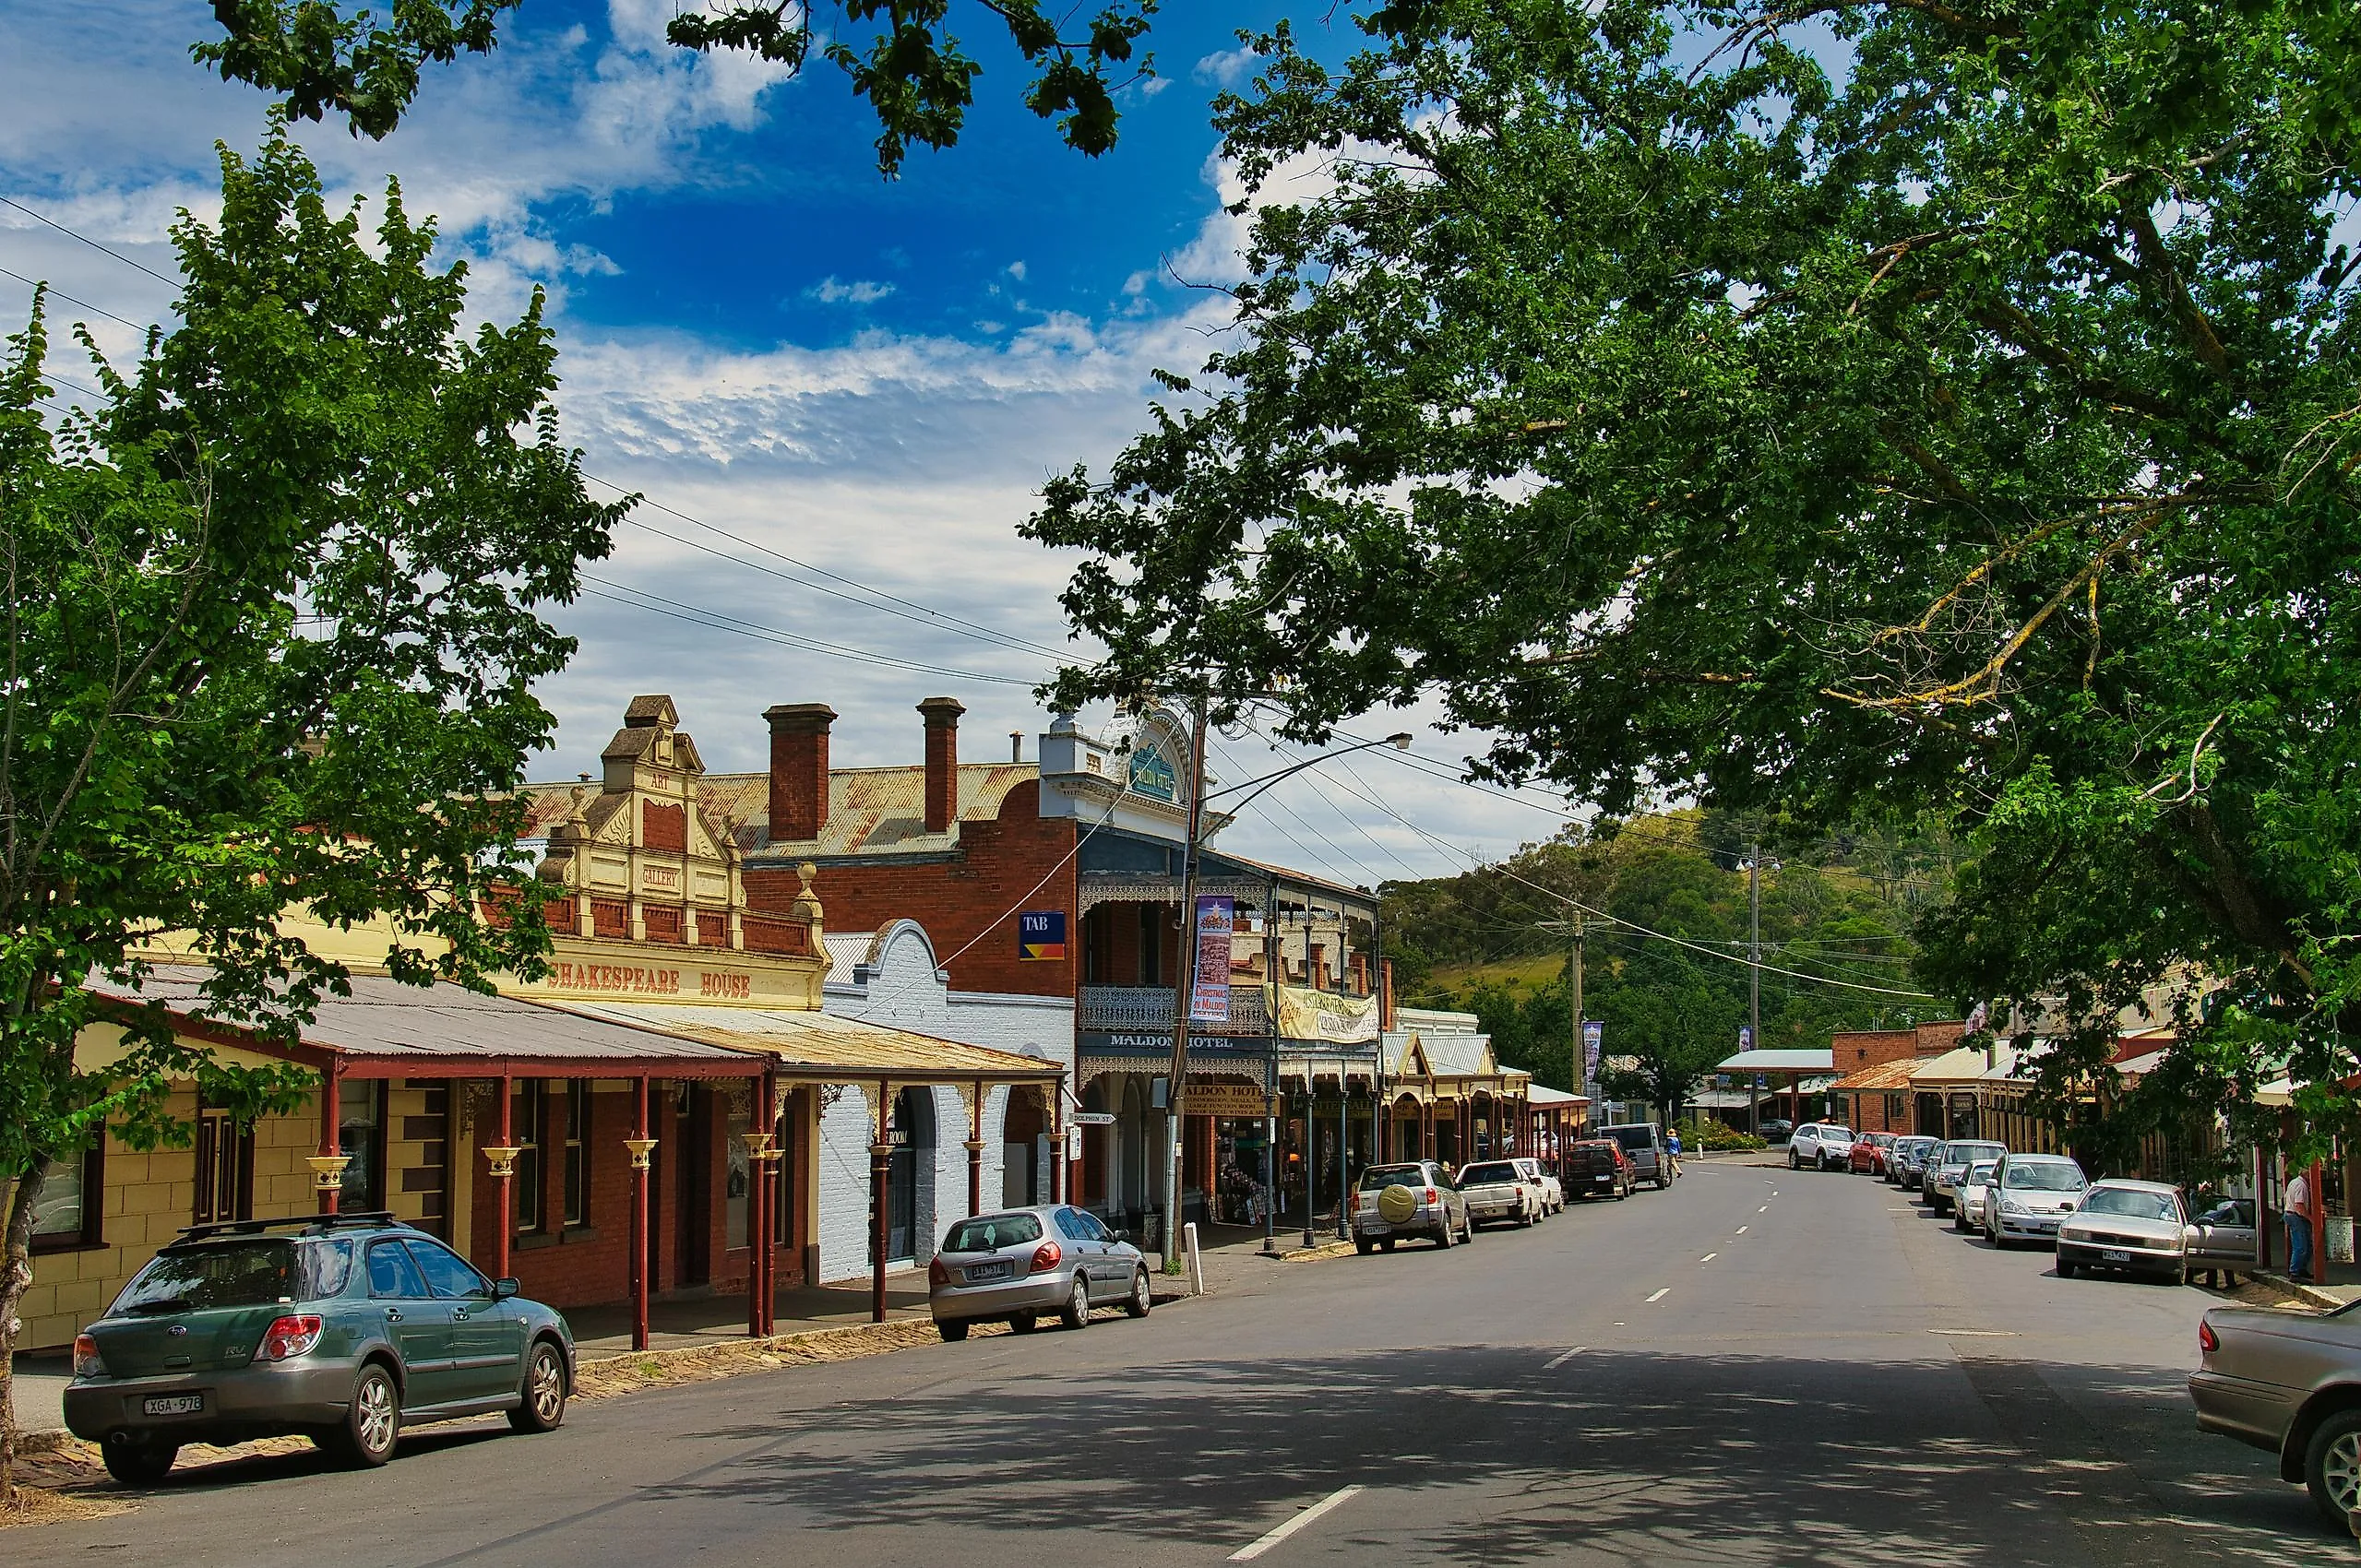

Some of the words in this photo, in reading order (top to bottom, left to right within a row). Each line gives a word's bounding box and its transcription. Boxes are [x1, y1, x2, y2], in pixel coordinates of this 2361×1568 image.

[651, 774, 669, 790] ART
[1158, 773, 1171, 791] HOTEL
[643, 869, 677, 886] GALLERY
[1023, 916, 1048, 931] TAB
[548, 962, 680, 994] SHAKESPEARE
[700, 972, 750, 998] HOUSE
[1185, 1087, 1227, 1096] ALDON
[888, 1130, 908, 1144] ROOM
